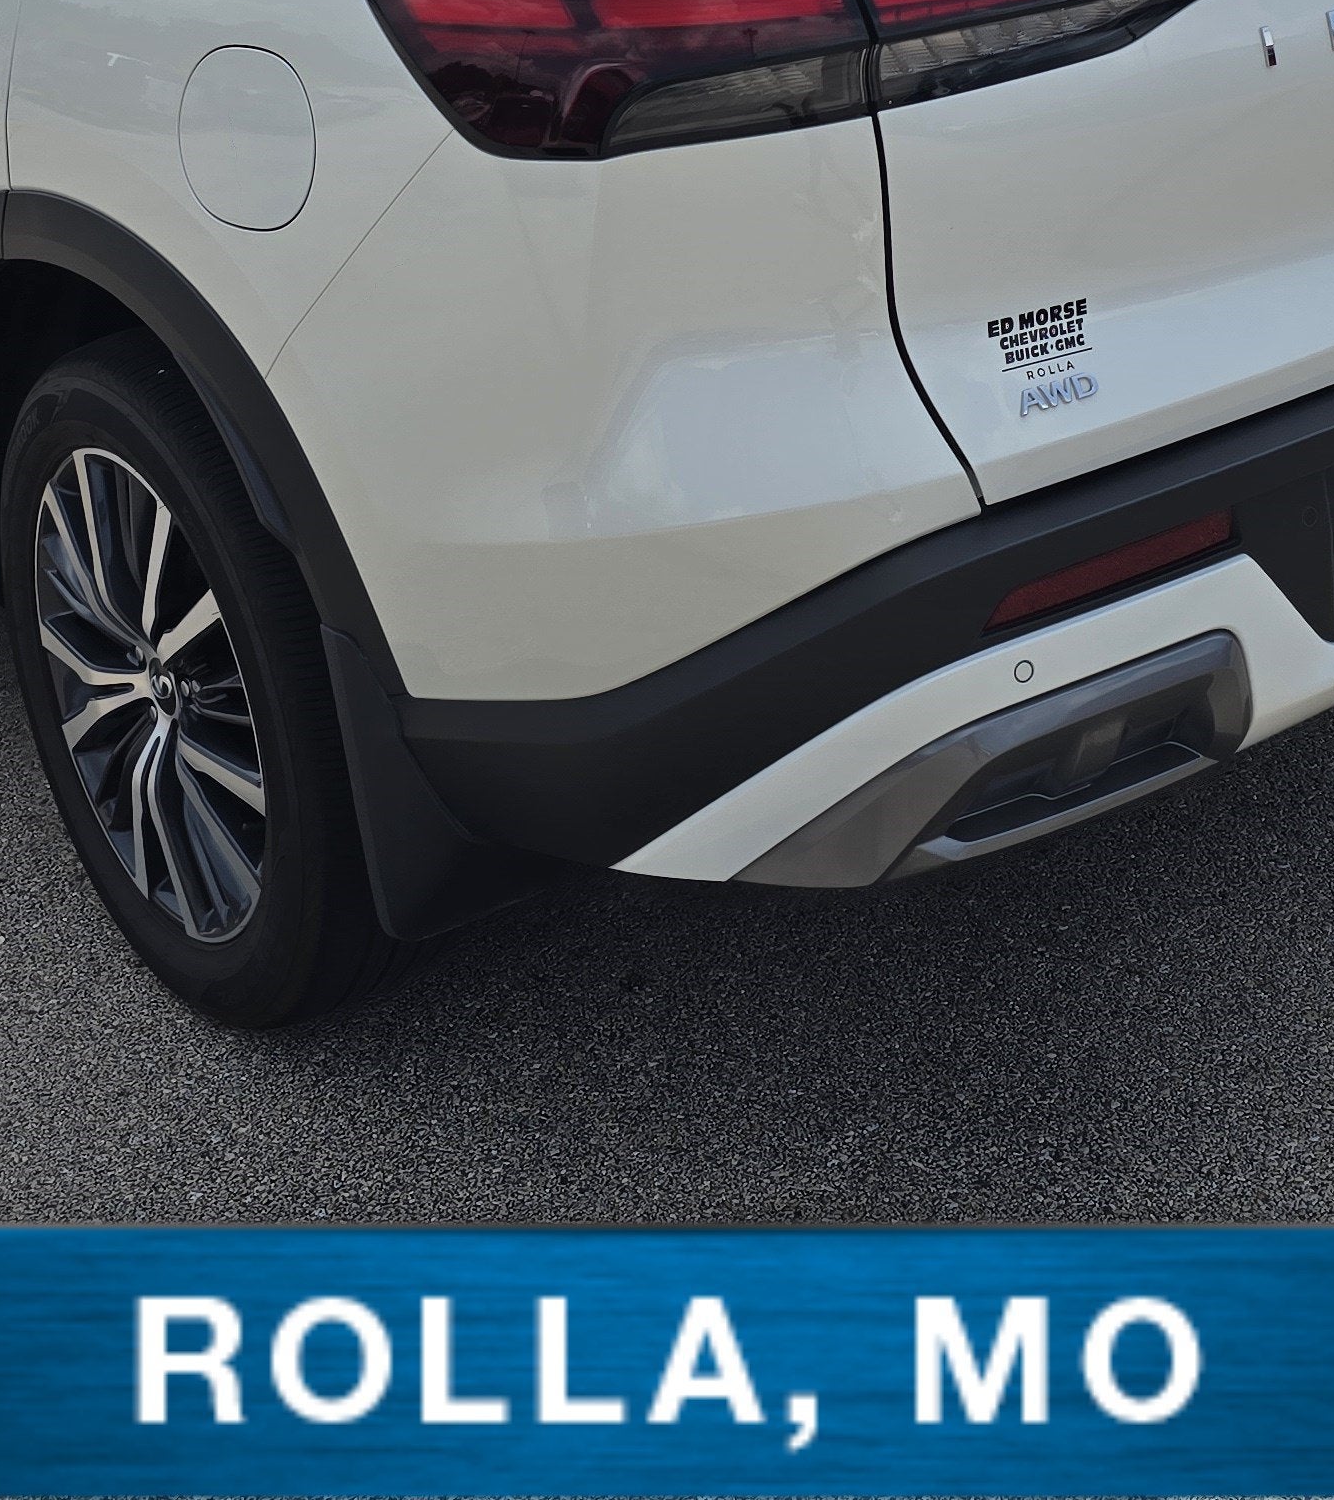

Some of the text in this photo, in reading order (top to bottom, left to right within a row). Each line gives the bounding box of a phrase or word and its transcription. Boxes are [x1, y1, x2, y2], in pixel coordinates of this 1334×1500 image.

[987, 298, 1087, 338] ED MORSE
[999, 318, 1084, 350] CHEVROLET
[1026, 360, 1075, 380] ROLLA
[1020, 372, 1100, 417] AWD
